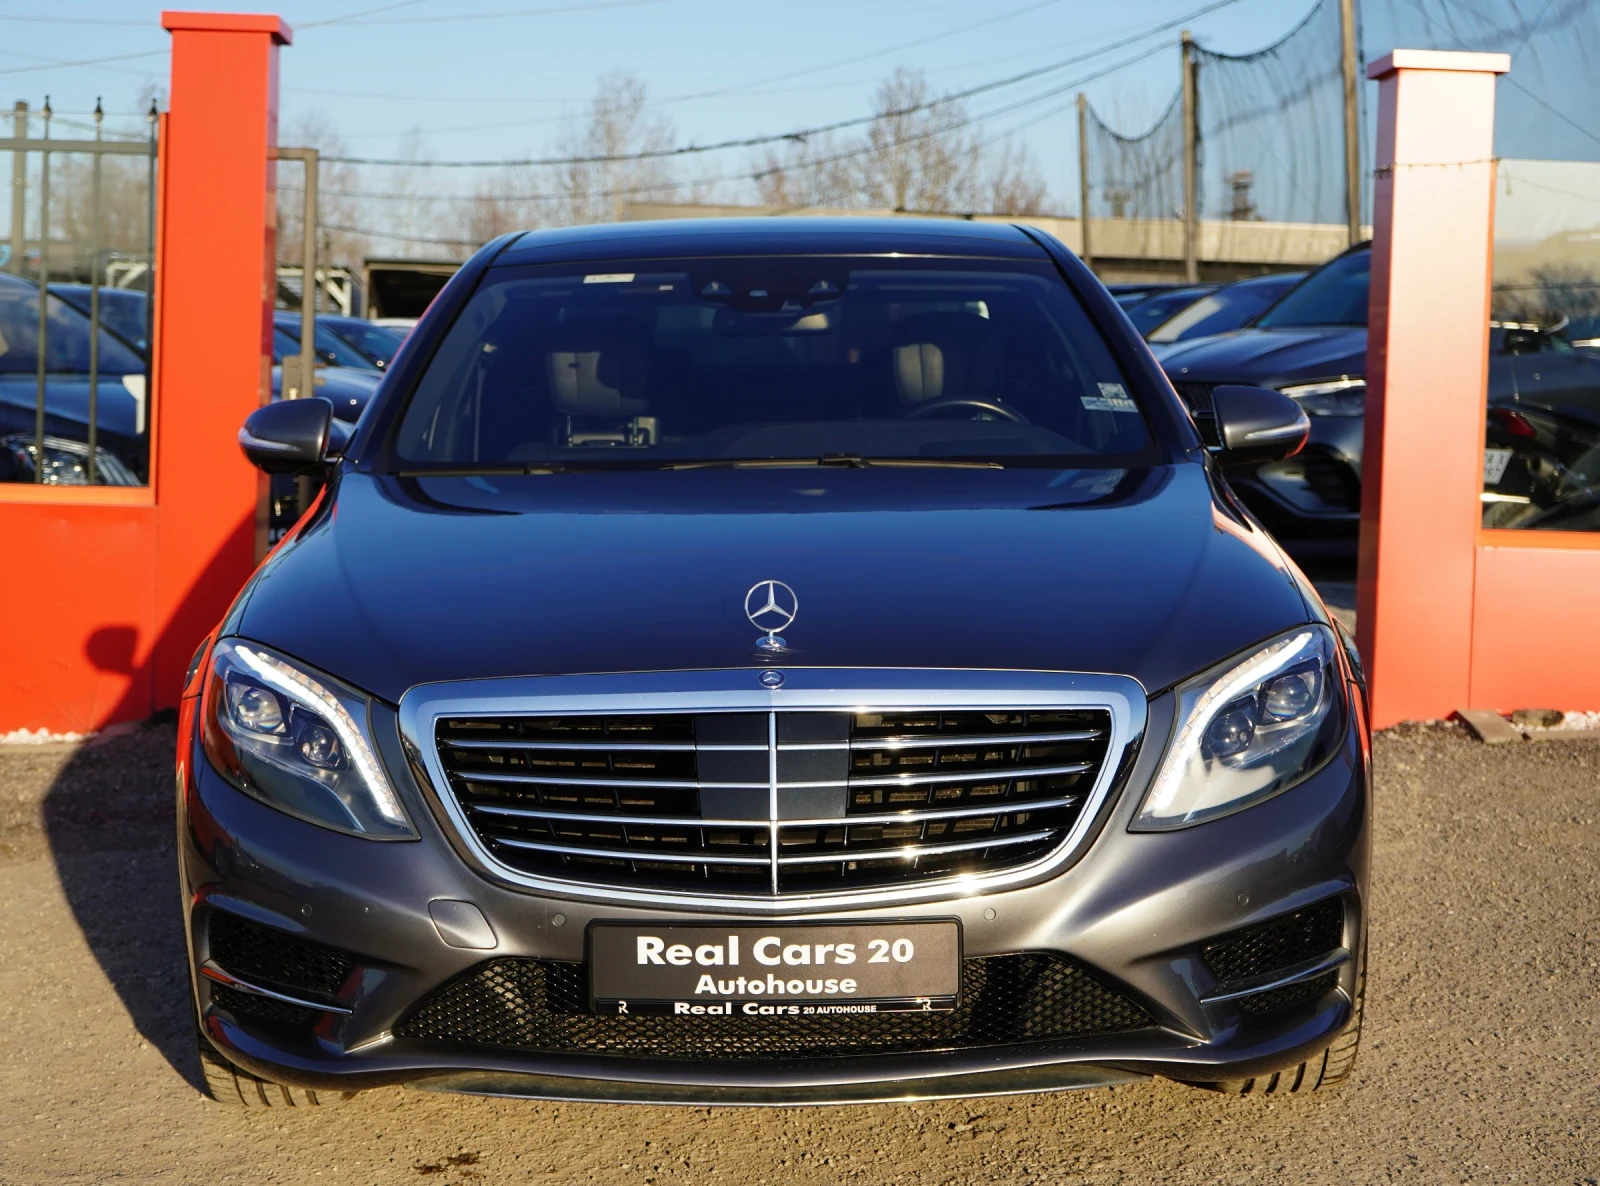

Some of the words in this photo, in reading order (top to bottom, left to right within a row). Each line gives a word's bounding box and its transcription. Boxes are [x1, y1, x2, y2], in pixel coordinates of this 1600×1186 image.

[636, 936, 739, 966] Real
[752, 936, 857, 966] Cars
[867, 938, 915, 963] 20
[694, 974, 858, 995] Autohouse
[674, 1002, 732, 1015] Real
[742, 1002, 800, 1015] Cars
[803, 1006, 815, 1015] 20
[816, 1005, 877, 1014] AUTOHOUSE
